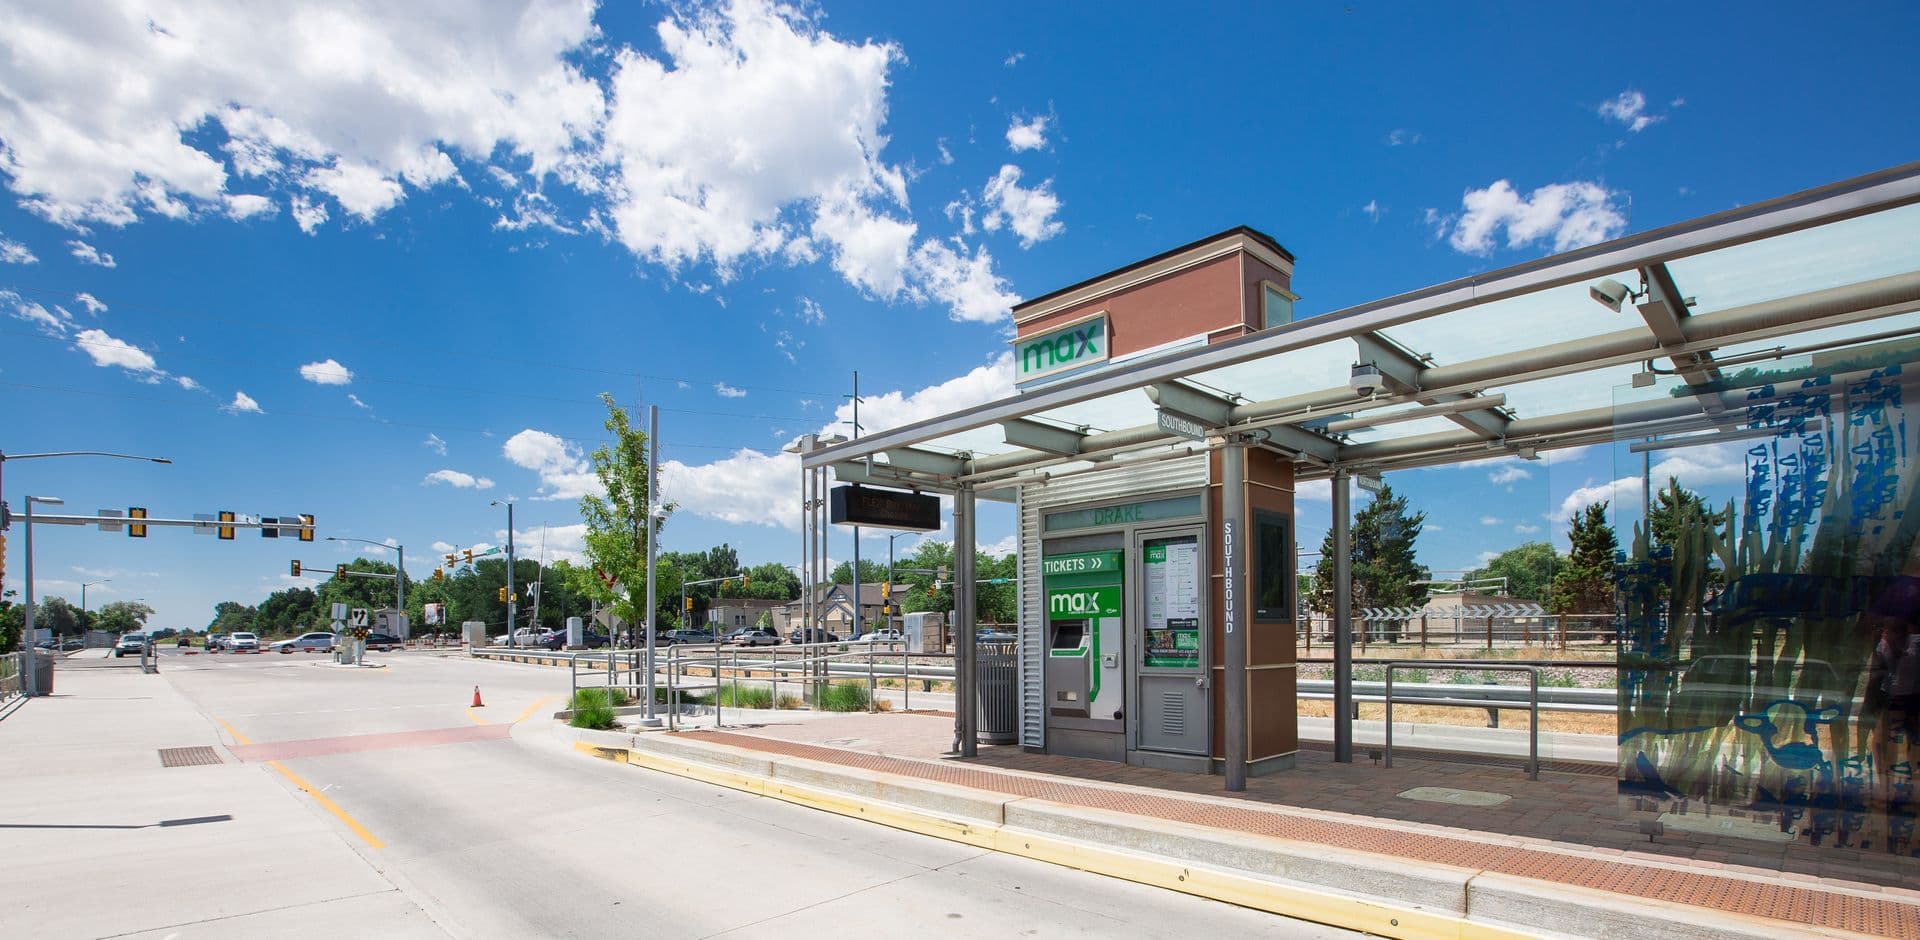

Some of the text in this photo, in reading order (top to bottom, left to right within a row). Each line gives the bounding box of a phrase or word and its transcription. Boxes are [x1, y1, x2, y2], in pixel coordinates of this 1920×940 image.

[1024, 325, 1097, 372] max
[1161, 414, 1204, 437] SOUTHBOUND
[1094, 504, 1144, 525] DRAKE
[1044, 558, 1085, 573] TICKETS
[1224, 522, 1234, 634] SOUTHBOUND
[1051, 592, 1099, 612] max
